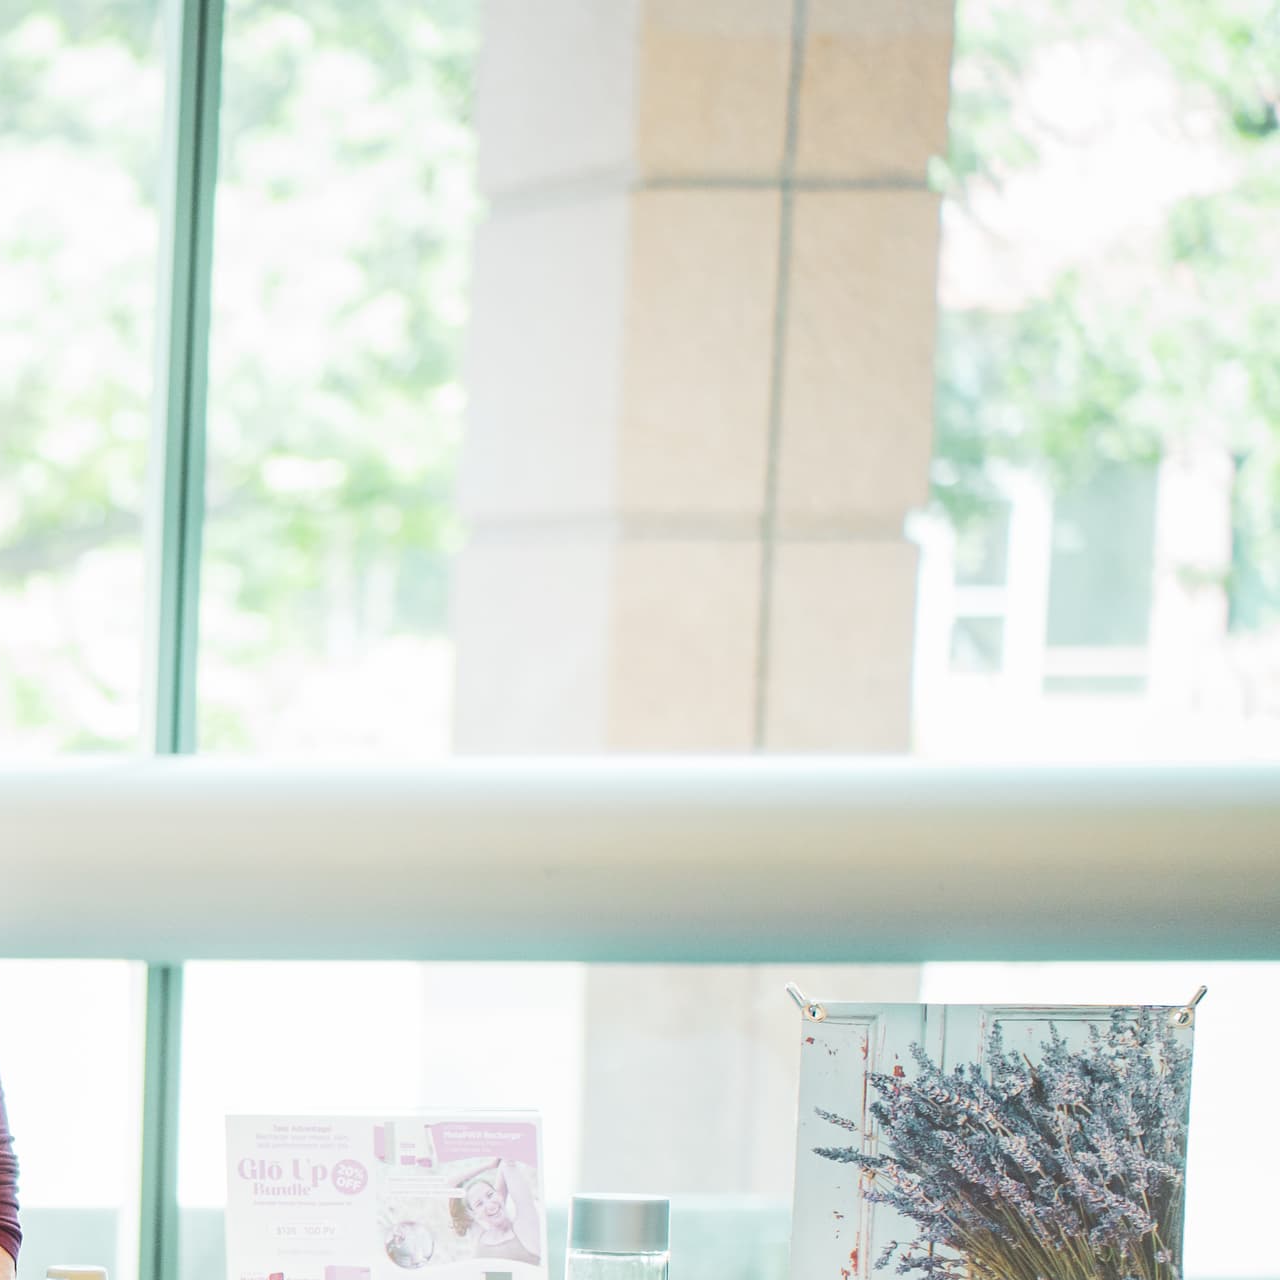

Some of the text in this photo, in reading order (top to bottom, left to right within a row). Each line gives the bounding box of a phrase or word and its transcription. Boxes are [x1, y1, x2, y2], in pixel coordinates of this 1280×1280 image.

[291, 1157, 329, 1189] Up
[335, 1164, 365, 1180] 20%
[253, 1183, 312, 1197] Bundle
[336, 1176, 362, 1191] OFF
